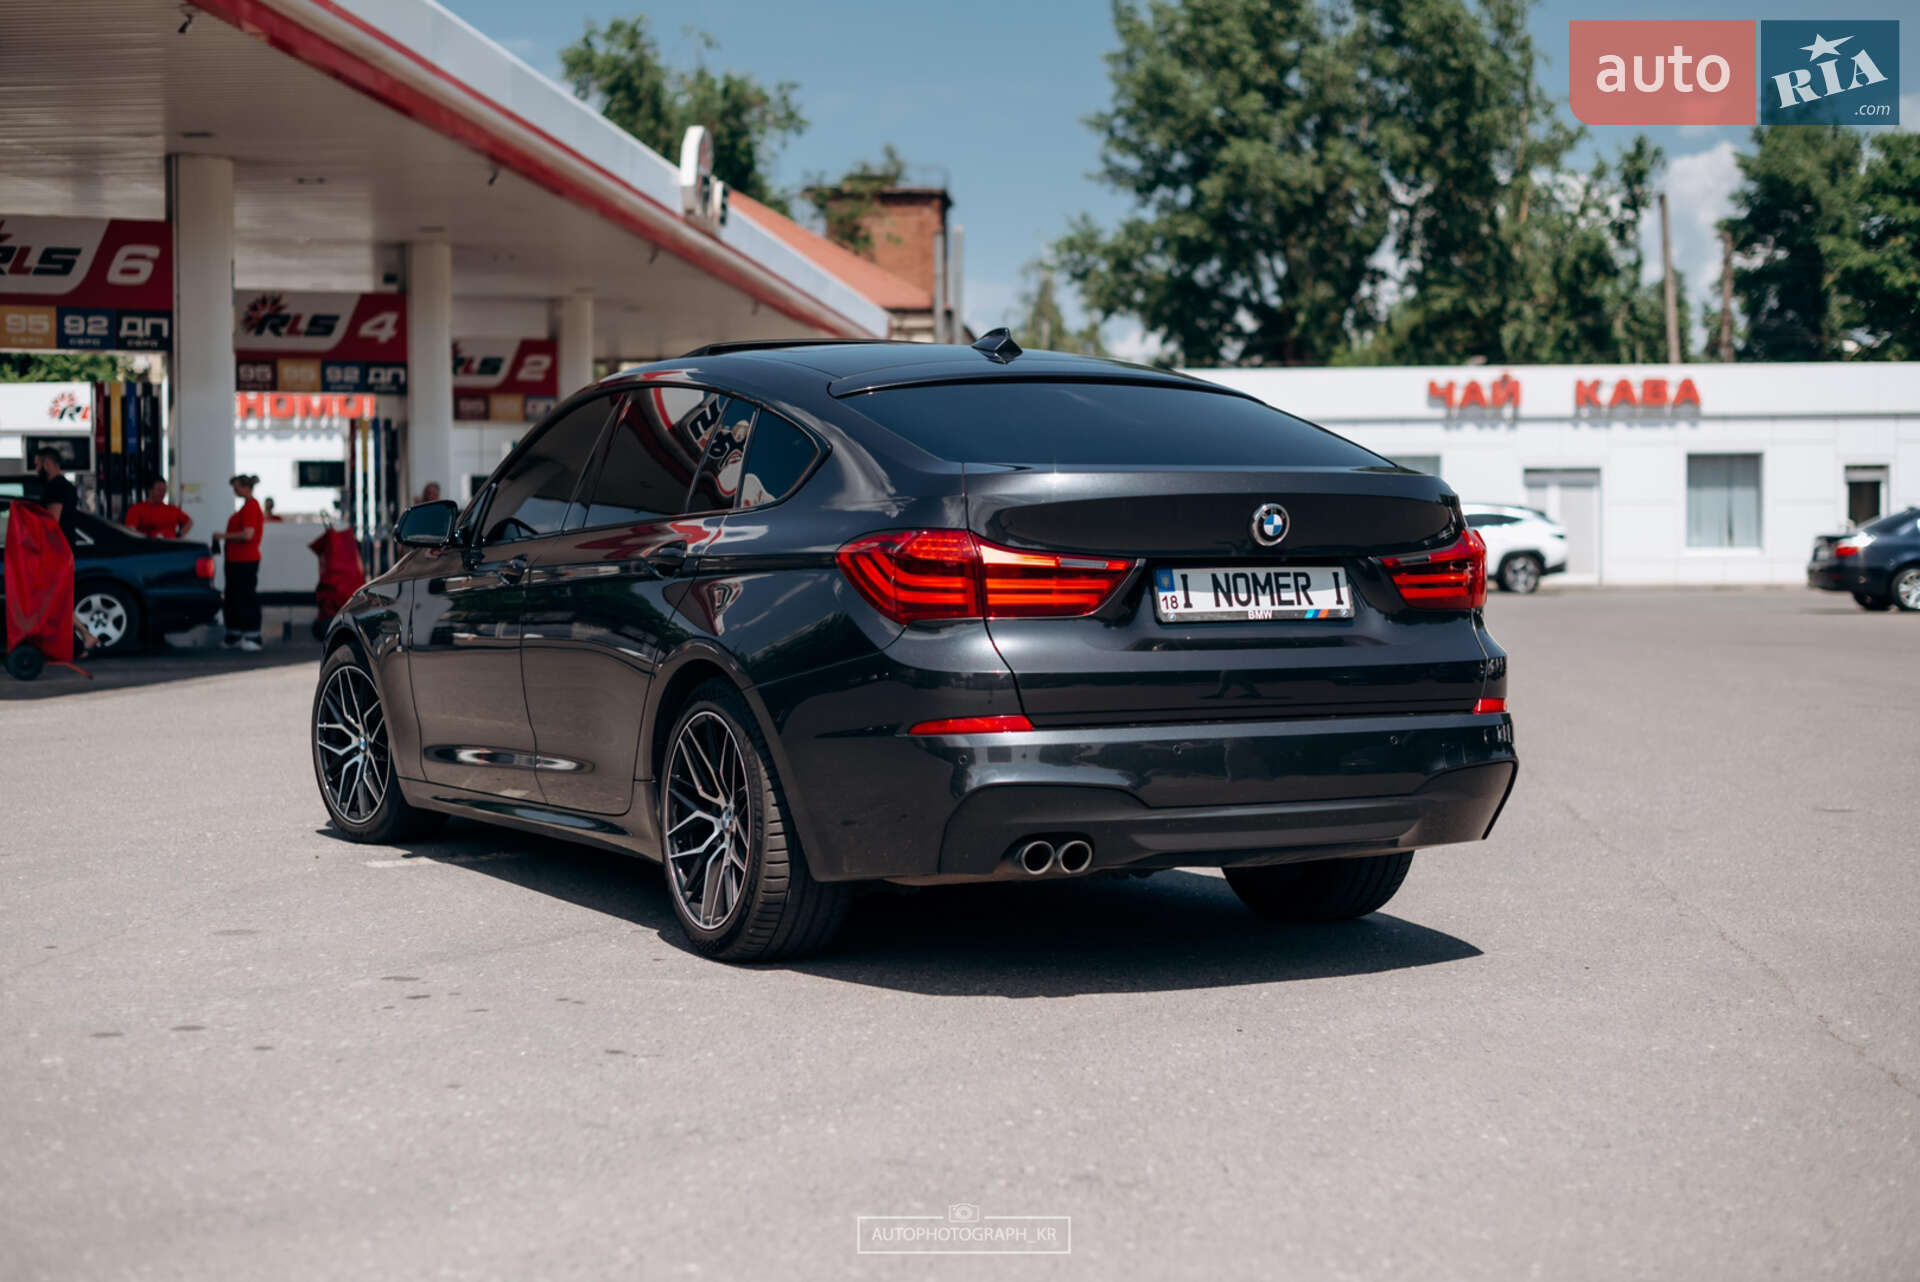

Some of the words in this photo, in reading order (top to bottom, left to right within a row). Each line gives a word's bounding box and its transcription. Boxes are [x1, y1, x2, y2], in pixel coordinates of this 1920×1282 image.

[107, 244, 160, 286] 6
[5, 313, 50, 335] 95
[64, 315, 109, 336] 92
[119, 316, 169, 338] ДП
[254, 313, 340, 337] RLS
[358, 312, 399, 343] 4
[516, 353, 553, 381] 2
[1428, 371, 1520, 408] ЧАЙ
[1575, 378, 1702, 407] КАВА
[1161, 595, 1179, 610] 18
[1211, 572, 1314, 608] NOMER
[1248, 609, 1273, 620] BMW
